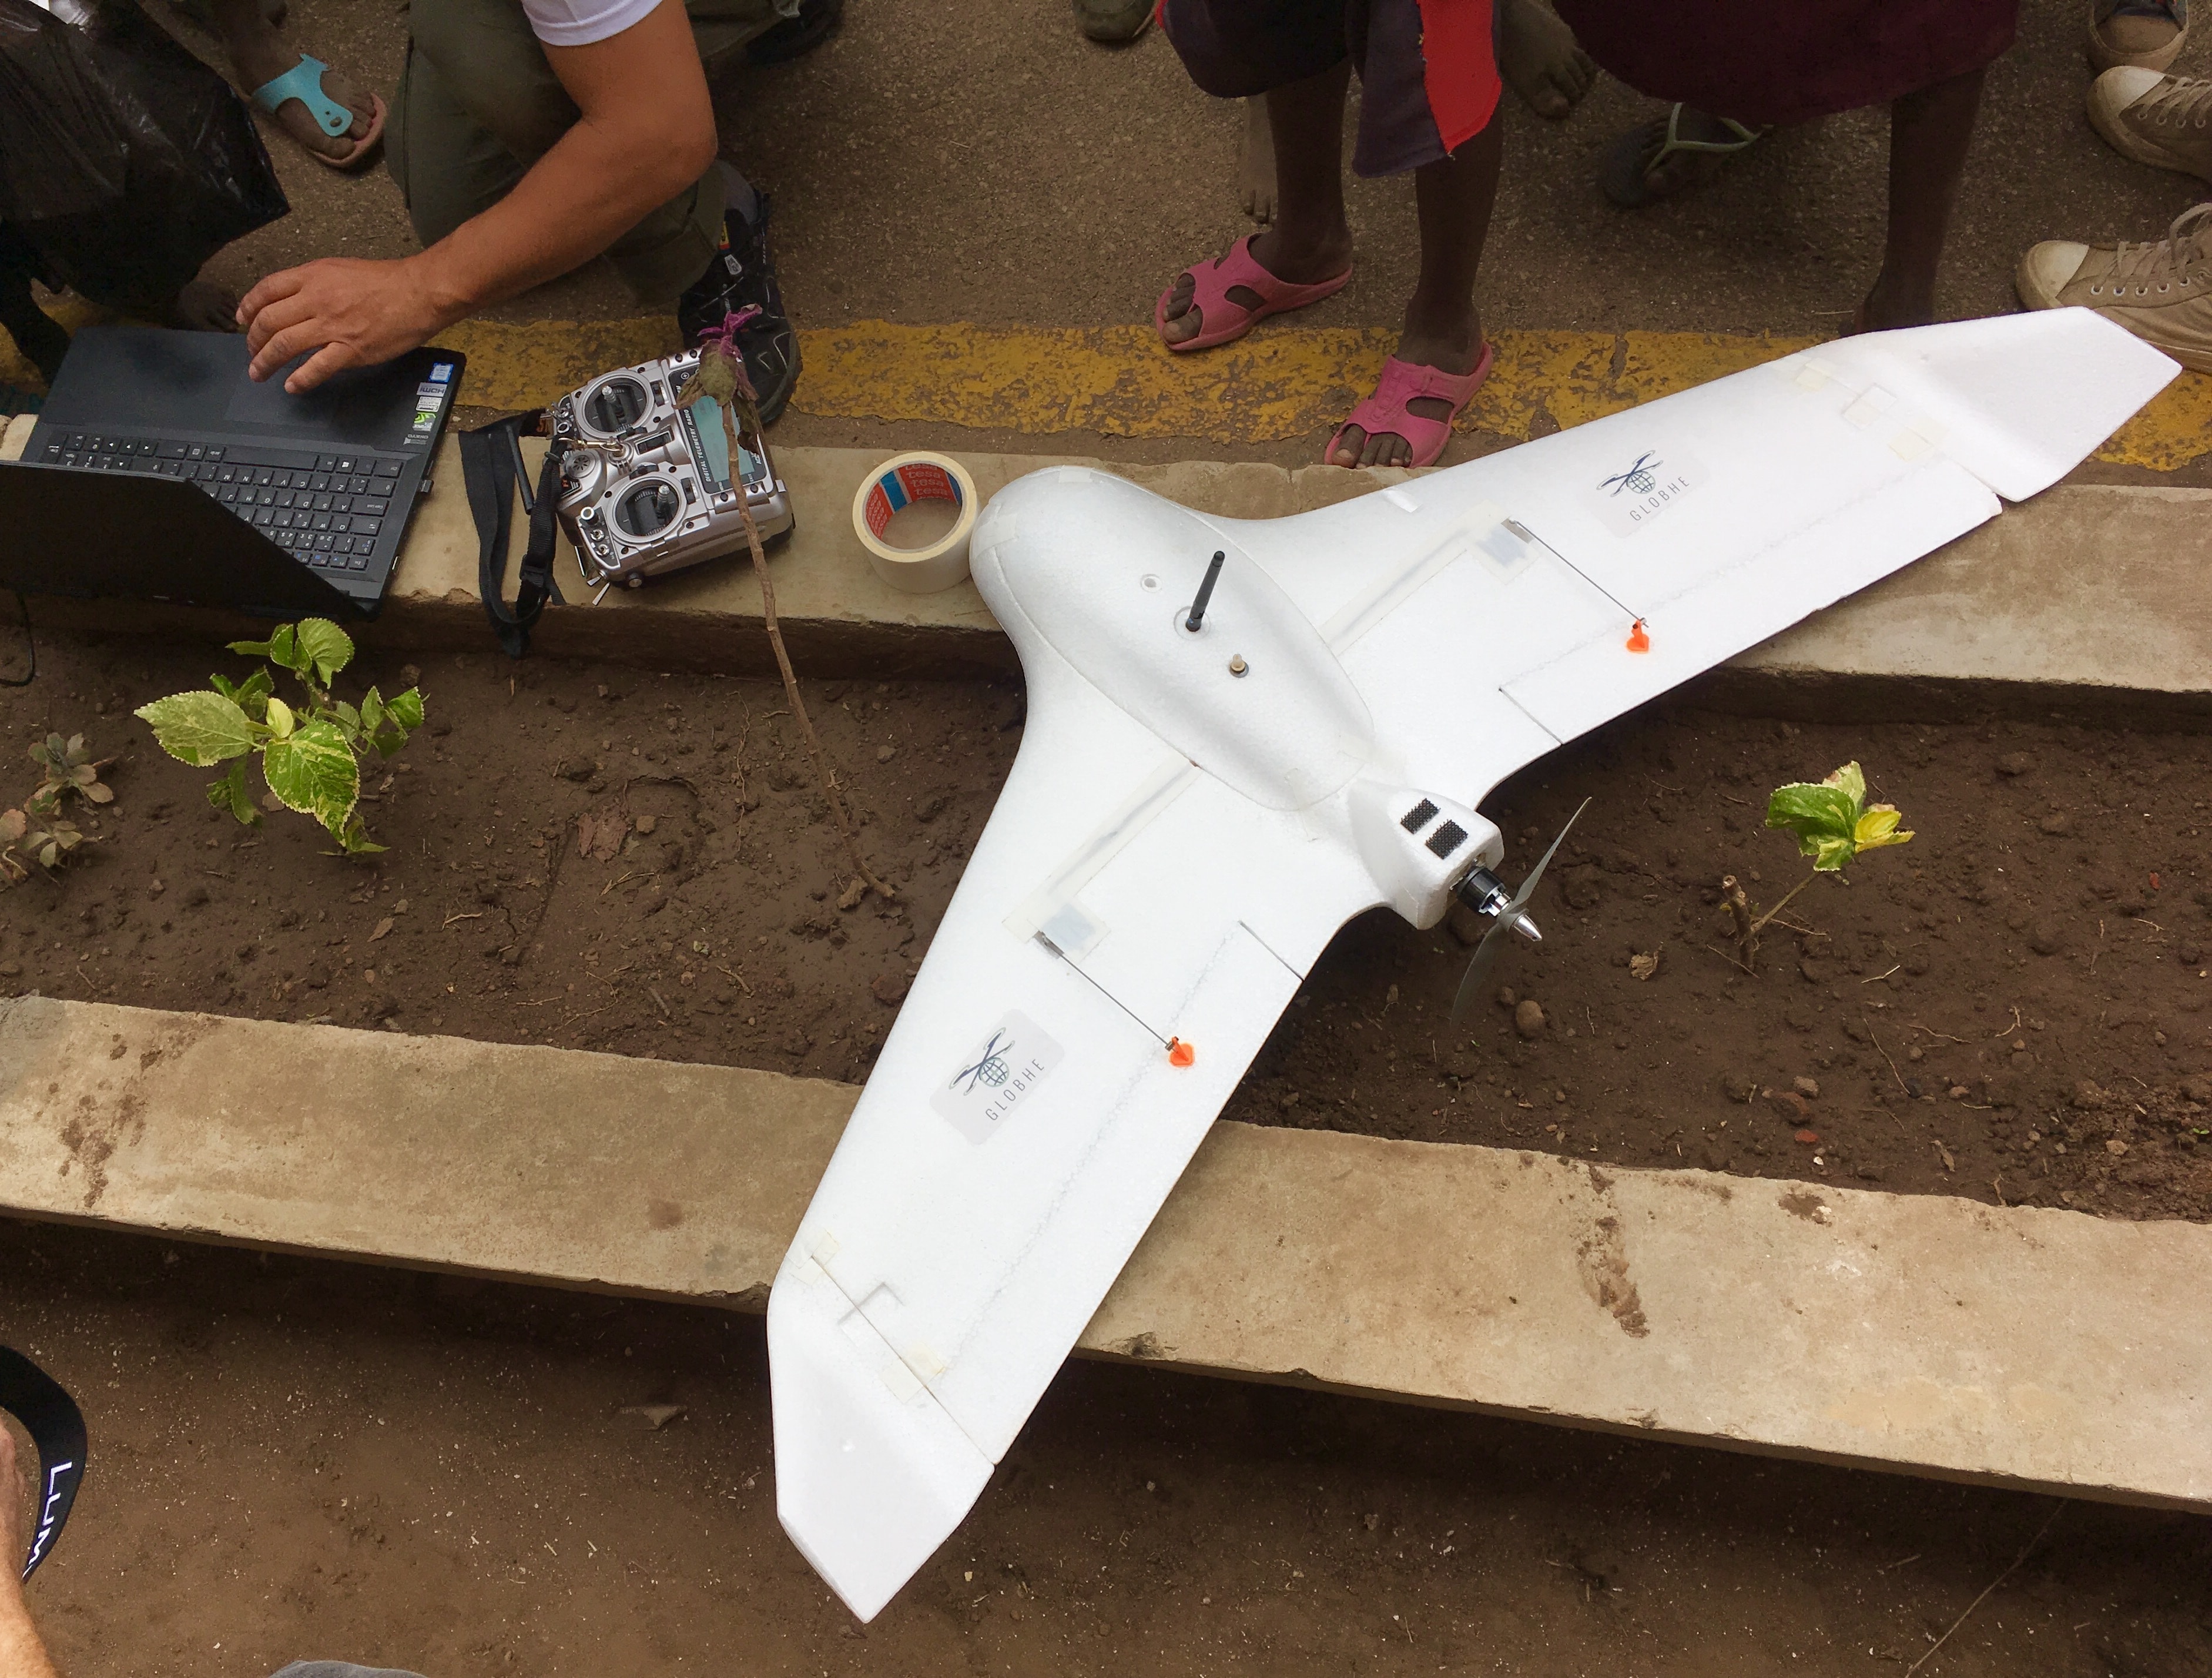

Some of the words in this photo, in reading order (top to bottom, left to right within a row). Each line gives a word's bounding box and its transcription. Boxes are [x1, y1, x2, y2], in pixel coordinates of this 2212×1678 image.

[683, 409, 693, 426] RADIO
[689, 428, 704, 458] TELEMETRY
[701, 461, 712, 482] DIGITAL
[916, 488, 948, 496] tesa
[1630, 477, 1690, 521] GLOBHE
[986, 1059, 1044, 1120] GLOBHE
